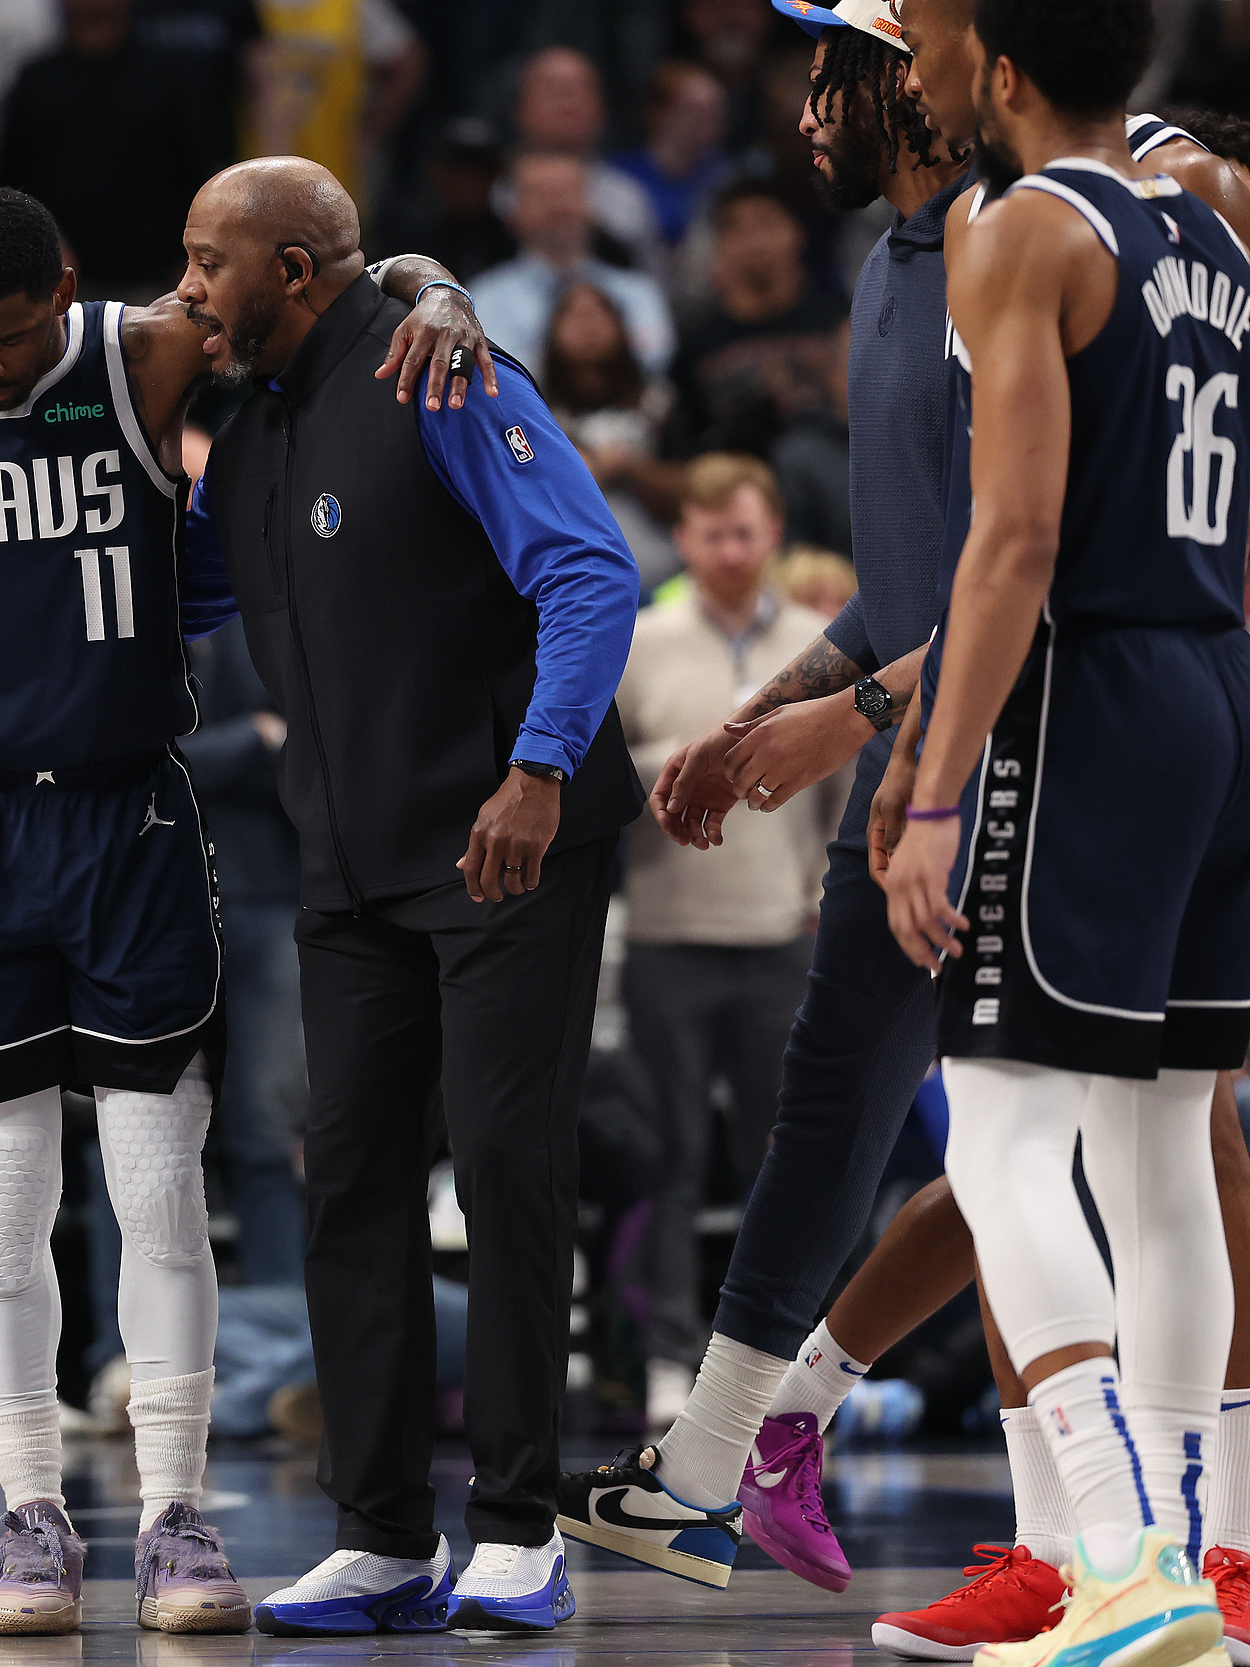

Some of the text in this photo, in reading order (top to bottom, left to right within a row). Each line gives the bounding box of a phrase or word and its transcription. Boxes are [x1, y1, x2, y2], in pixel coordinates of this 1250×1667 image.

[44, 401, 105, 424] chime
[1165, 363, 1239, 546] 26
[74, 545, 135, 642] 11
[972, 758, 1021, 1025] MAVERICKS
